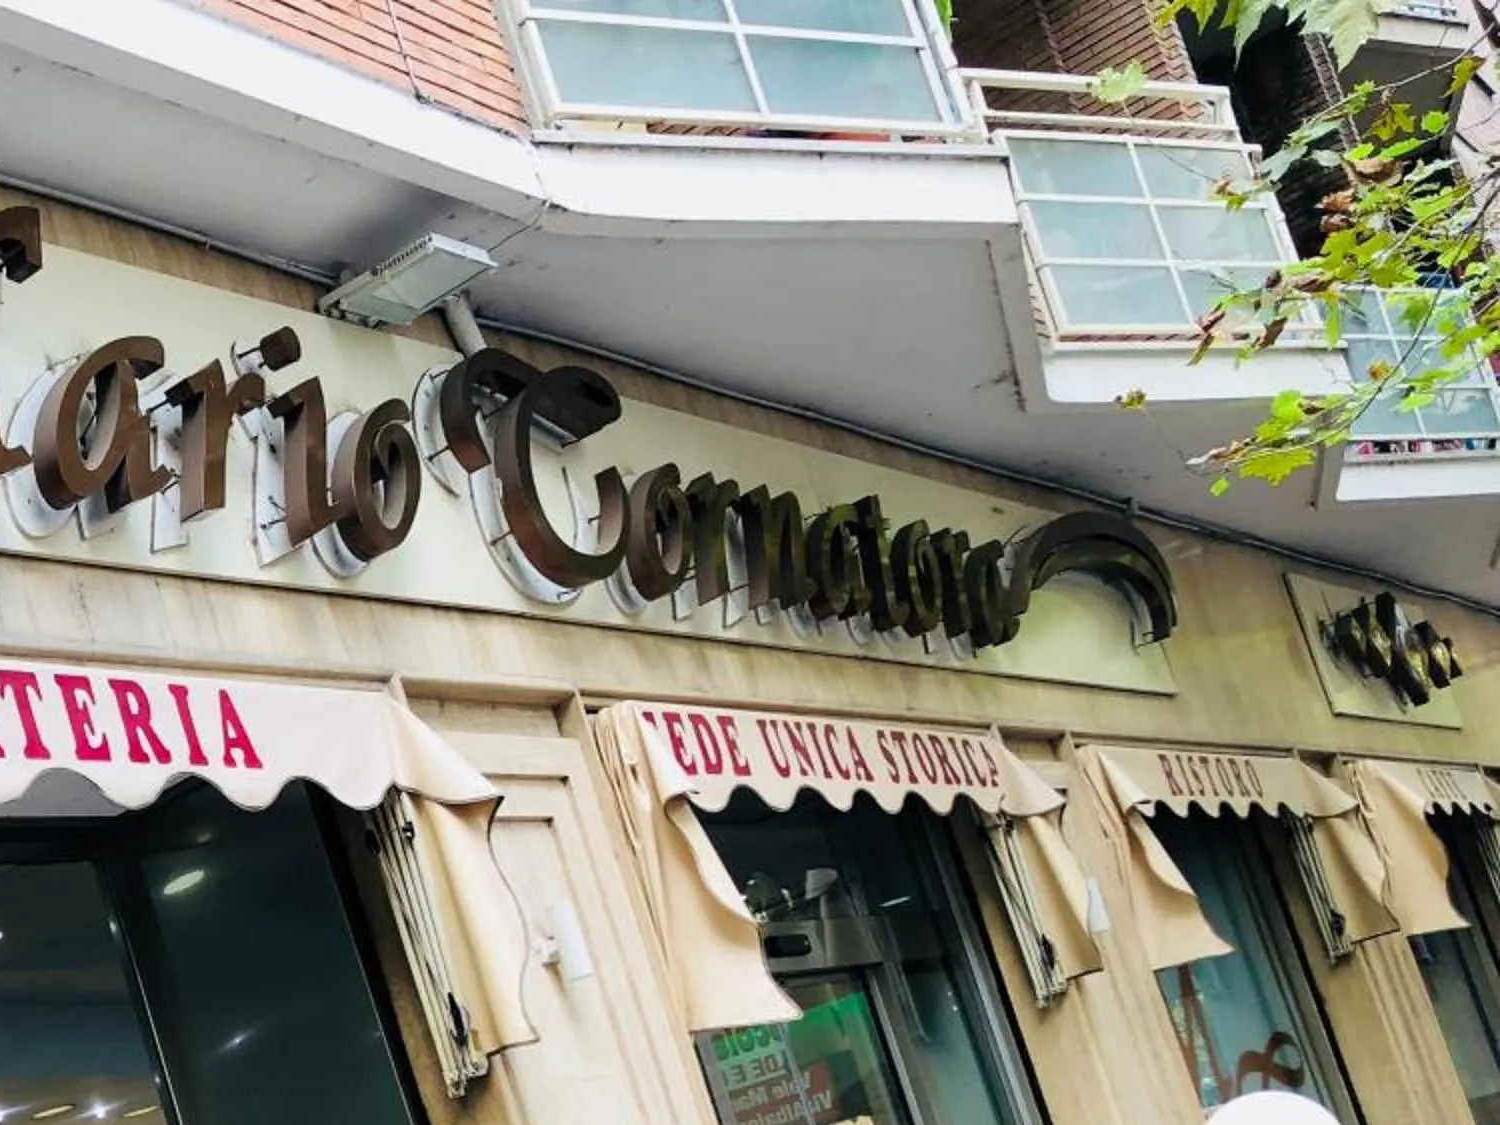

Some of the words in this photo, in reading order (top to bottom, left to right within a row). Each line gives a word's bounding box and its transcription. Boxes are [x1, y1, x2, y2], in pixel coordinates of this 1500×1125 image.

[756, 718, 875, 782] UNICA
[876, 729, 1000, 788] STORICA
[1157, 753, 1263, 798] RISTORO
